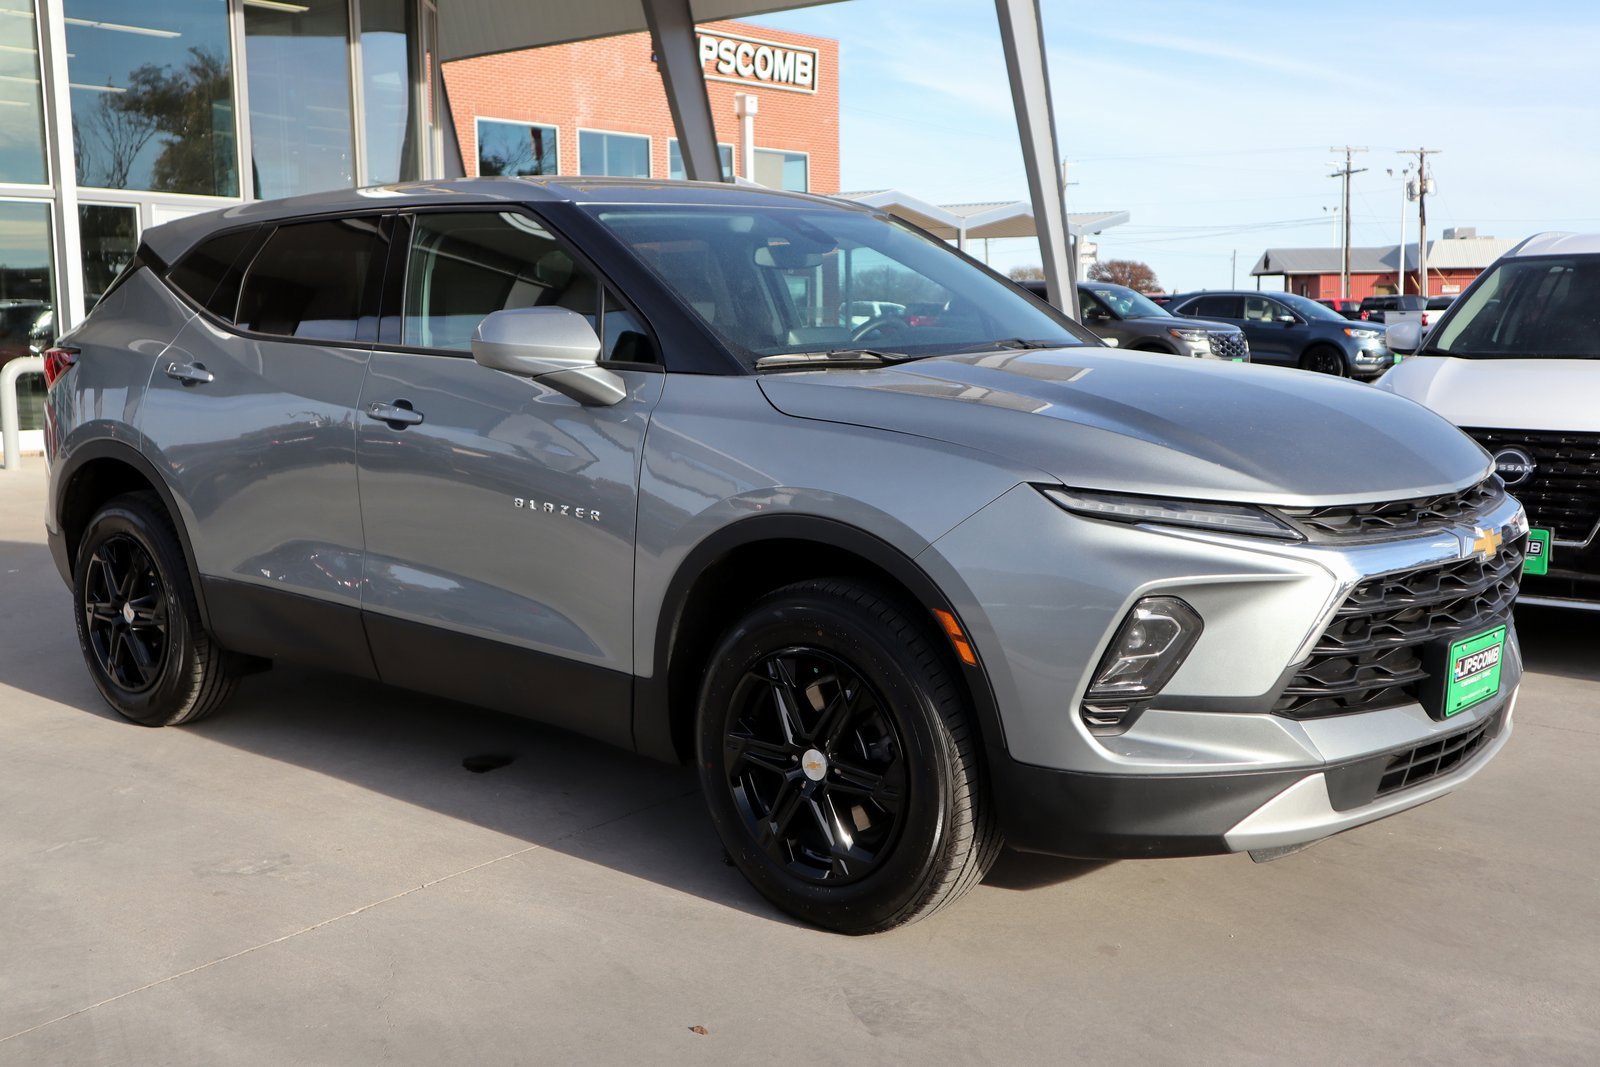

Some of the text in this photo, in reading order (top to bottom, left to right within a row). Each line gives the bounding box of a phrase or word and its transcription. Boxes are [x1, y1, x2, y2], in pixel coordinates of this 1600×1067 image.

[699, 36, 813, 85] PSCOMB
[1496, 464, 1532, 473] SSAN
[514, 498, 600, 521] BLAZER
[1457, 647, 1500, 677] LIPSCOMB
